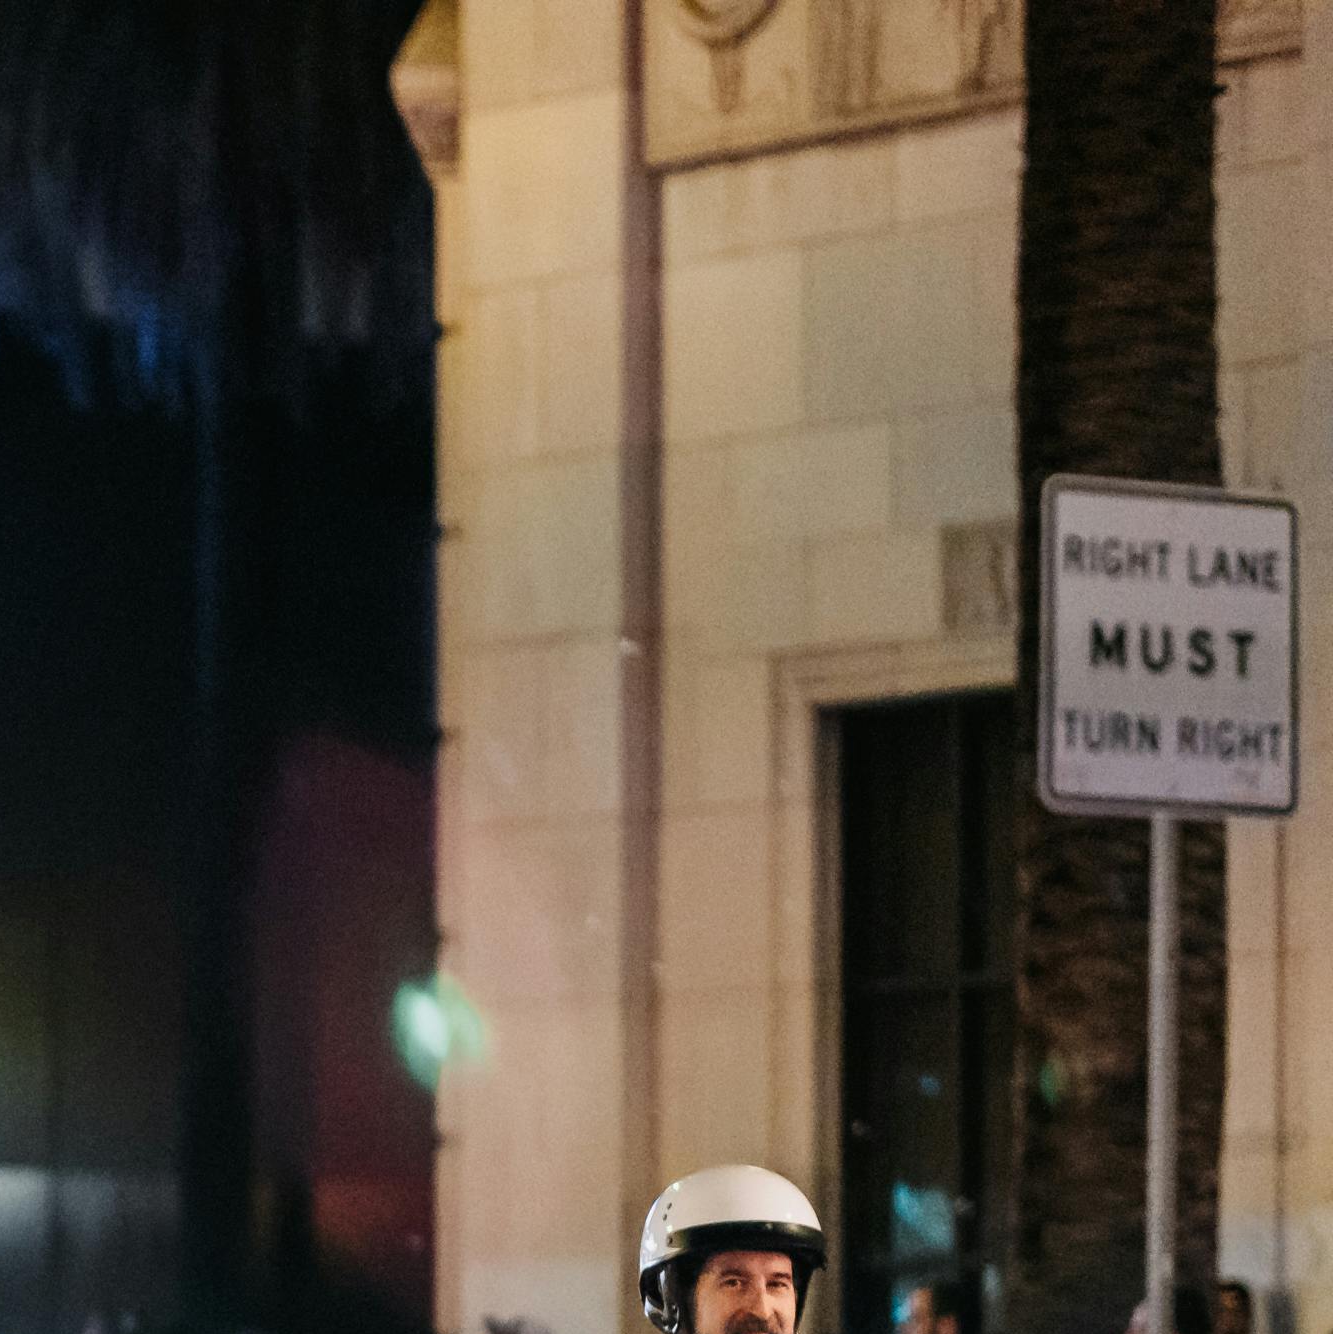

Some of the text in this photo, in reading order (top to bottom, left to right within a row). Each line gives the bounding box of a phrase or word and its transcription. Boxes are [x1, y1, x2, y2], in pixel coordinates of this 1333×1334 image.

[1062, 532, 1282, 594] RIGHT LANE
[1088, 619, 1255, 680] MUST
[1063, 708, 1283, 766] TURN RIGHT
